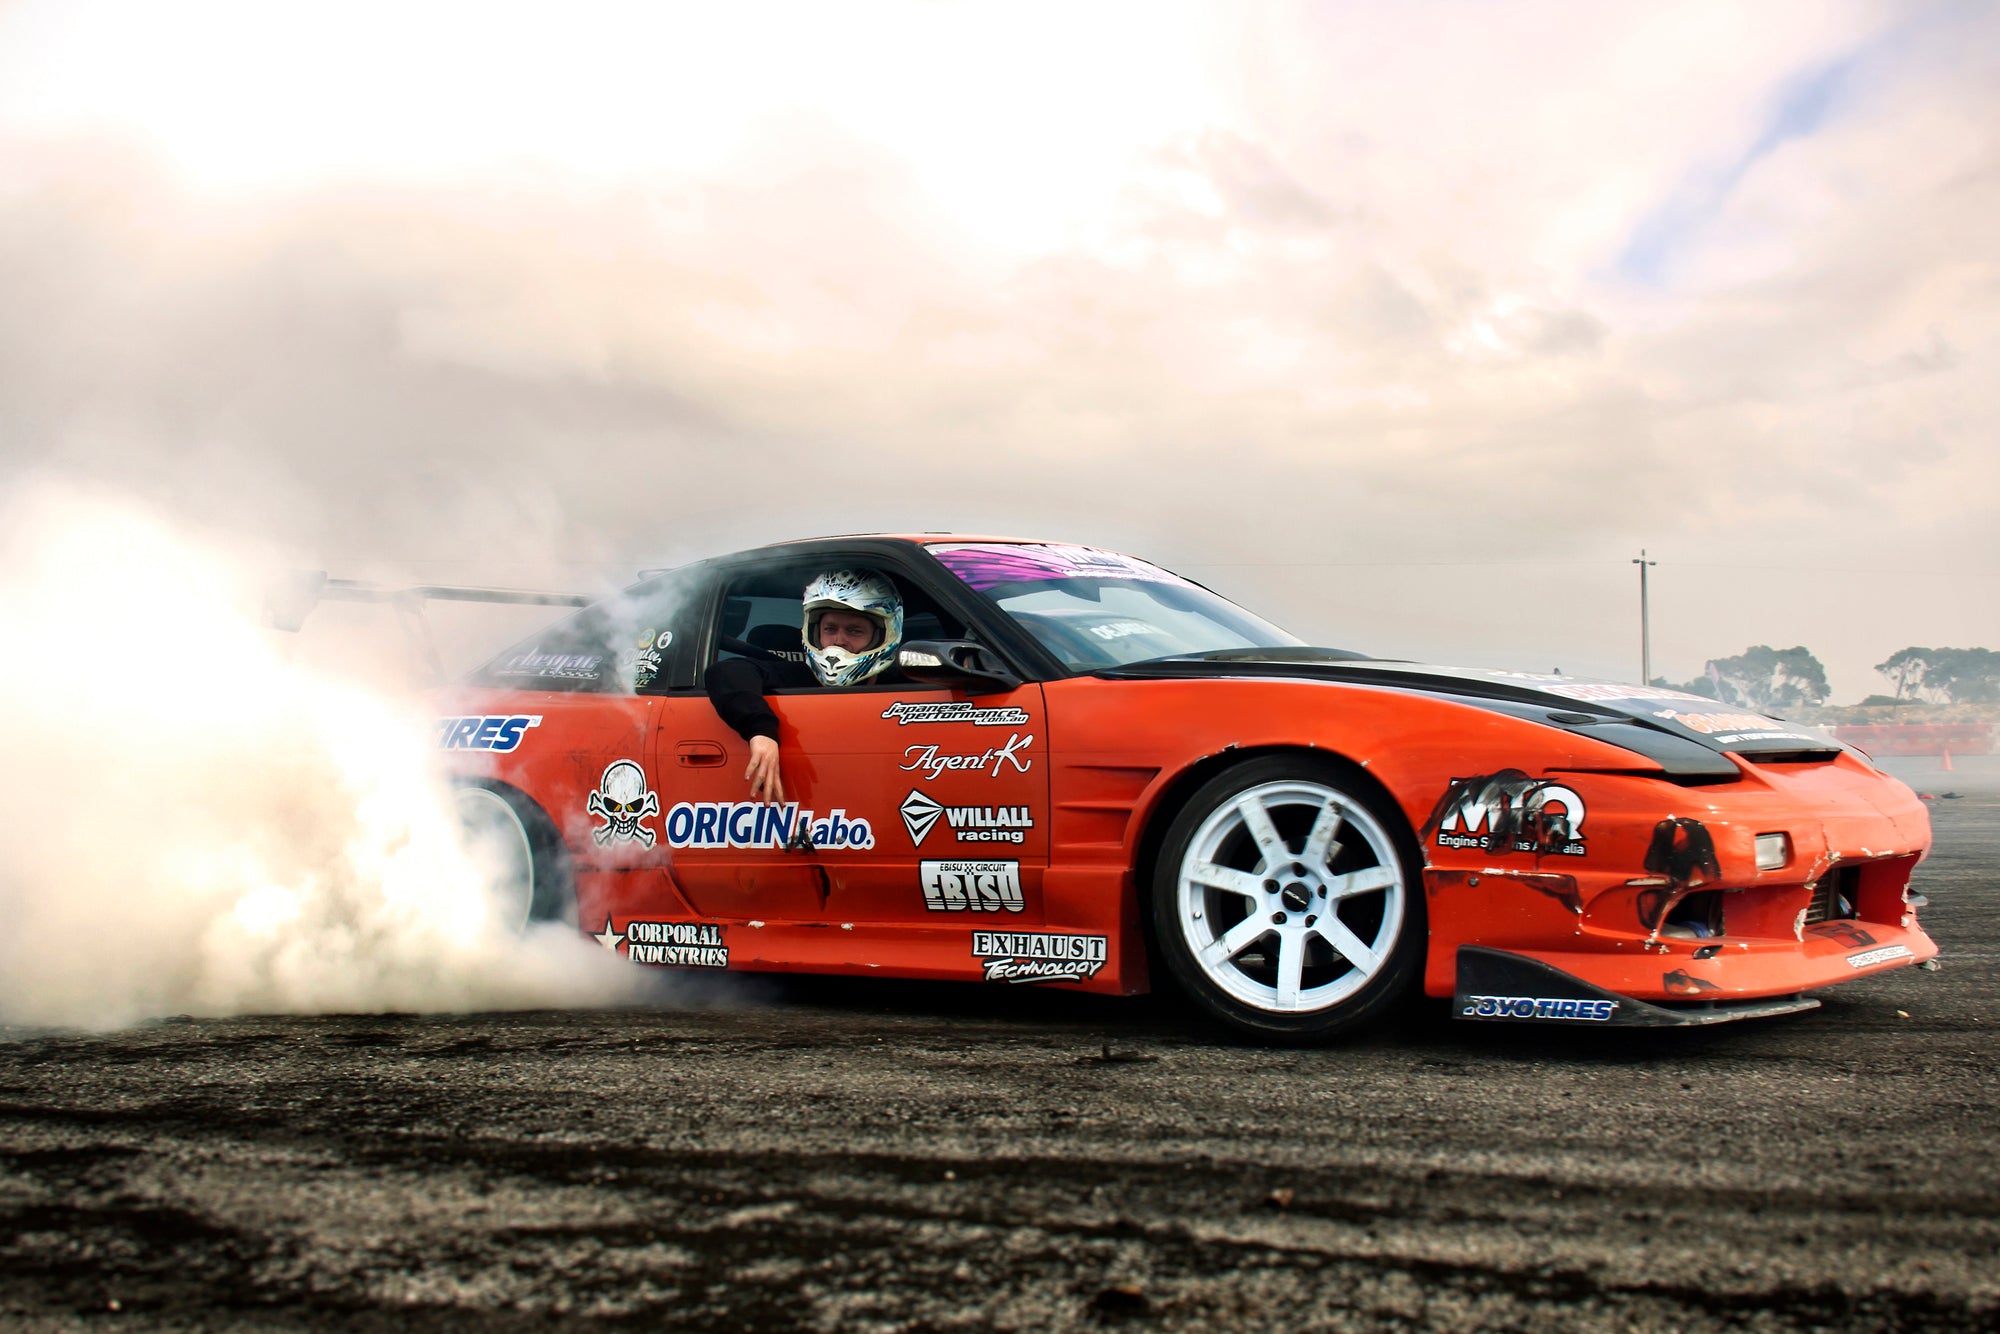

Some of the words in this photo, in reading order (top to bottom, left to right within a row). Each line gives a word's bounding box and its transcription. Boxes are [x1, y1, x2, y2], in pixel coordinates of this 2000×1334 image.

[888, 703, 970, 715] japanese
[903, 709, 1019, 722] performance
[668, 804, 794, 845] ORIGIN
[945, 807, 1033, 827] WILLALL
[957, 829, 1024, 843] racing
[1438, 834, 1478, 849] Engine
[940, 863, 963, 872] EBISU
[975, 863, 1007, 872] CIRCUIT
[627, 922, 721, 946] CORPORAL
[628, 944, 728, 967] INDUSTRIES
[976, 934, 1104, 958] EXHAUST
[983, 957, 1103, 981] TECHNOLOGY
